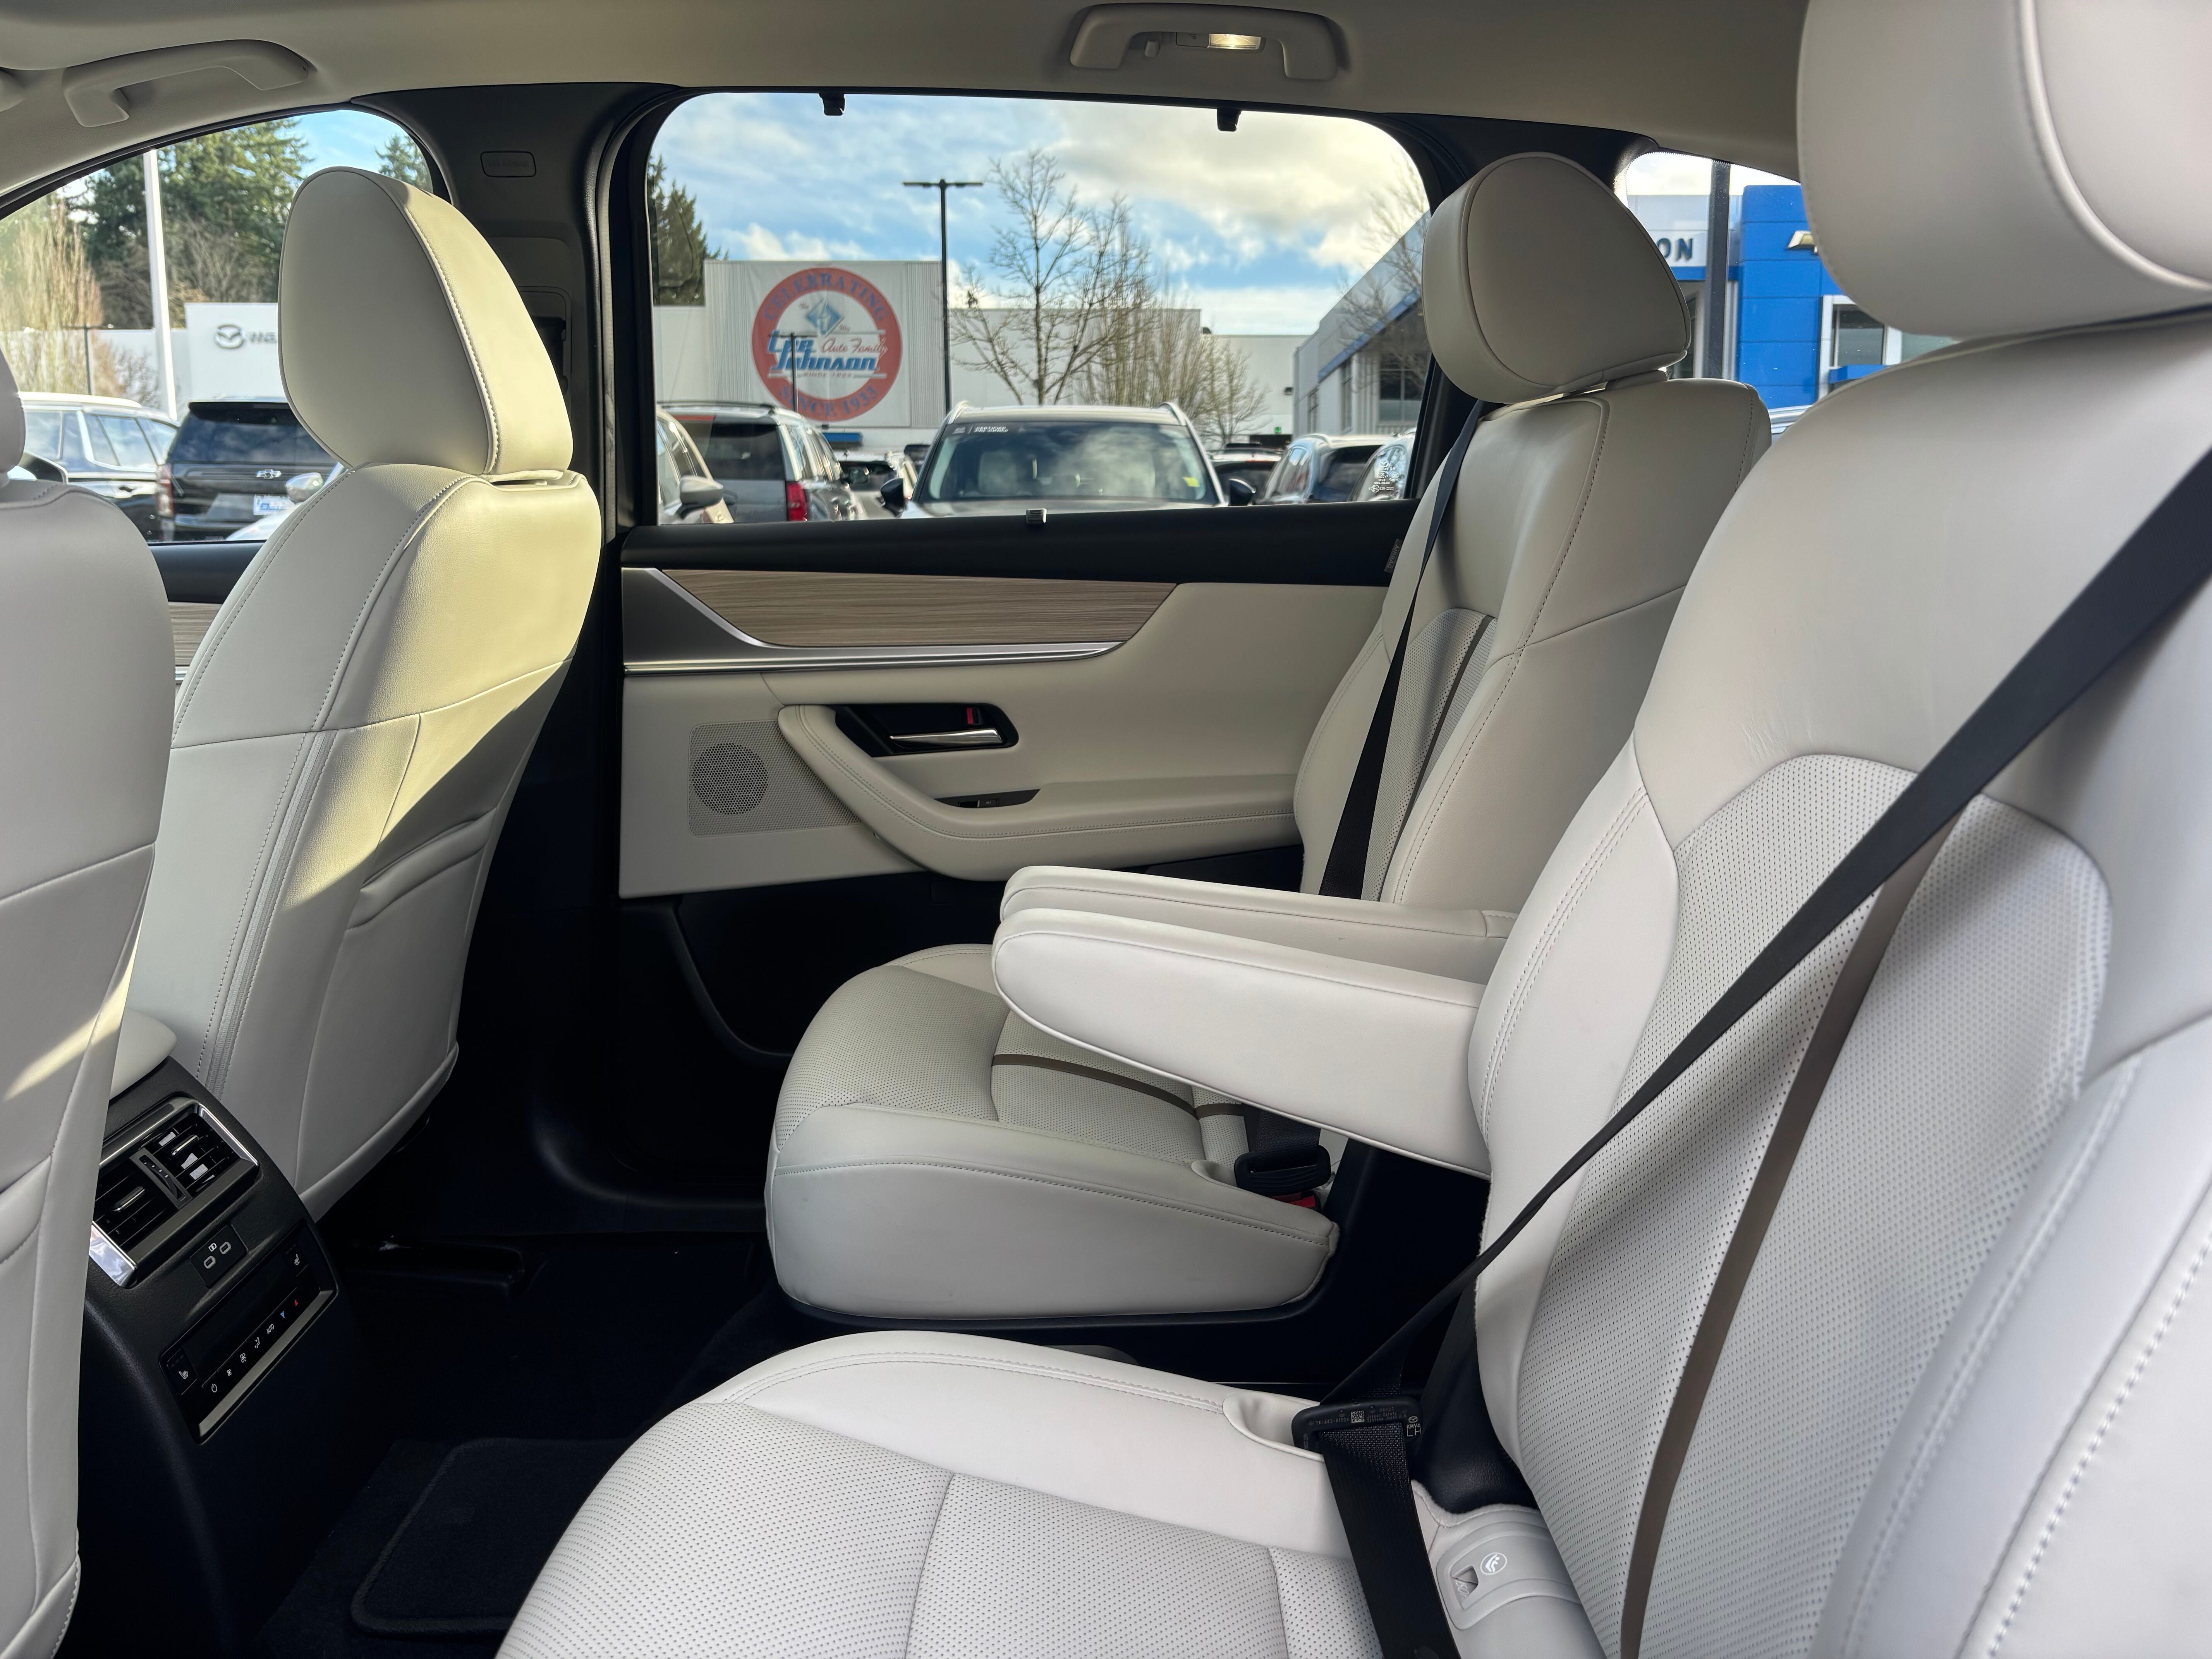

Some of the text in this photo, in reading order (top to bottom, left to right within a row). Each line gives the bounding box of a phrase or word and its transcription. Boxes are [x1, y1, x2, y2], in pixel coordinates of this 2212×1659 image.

[763, 273, 889, 321] CELEBRATING
[823, 337, 848, 353] Auto
[850, 338, 888, 359] Family
[843, 385, 878, 414] 1933
[1387, 544, 1399, 568] AIRBAG
[266, 1324, 275, 1334] AUTO
